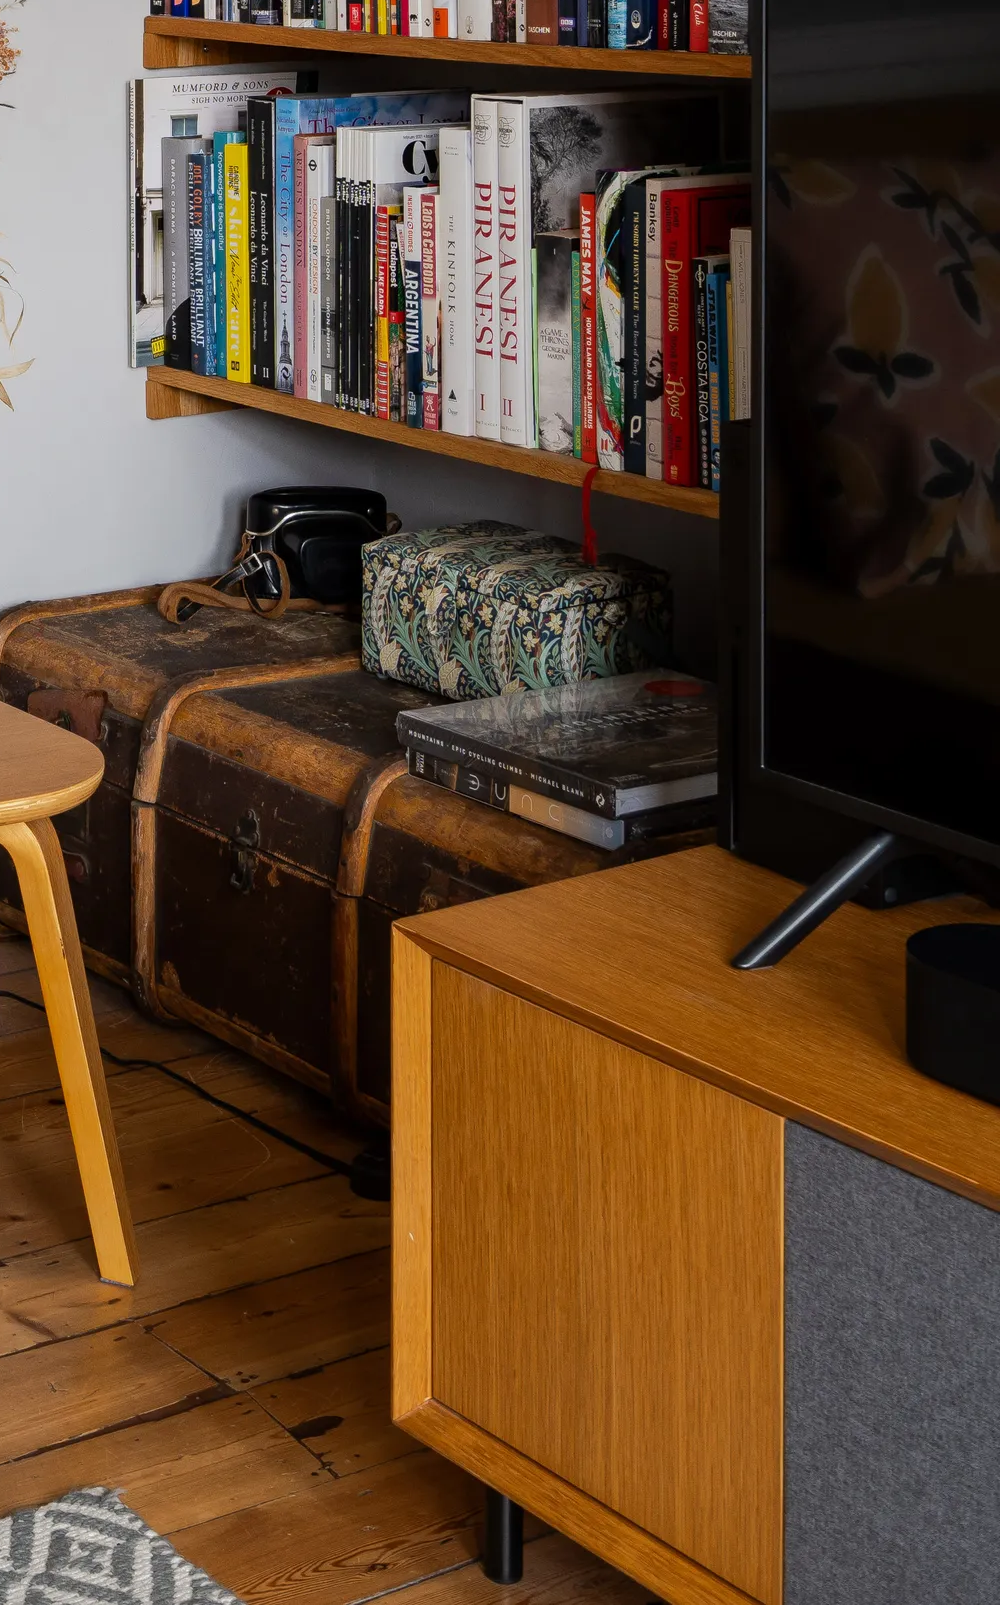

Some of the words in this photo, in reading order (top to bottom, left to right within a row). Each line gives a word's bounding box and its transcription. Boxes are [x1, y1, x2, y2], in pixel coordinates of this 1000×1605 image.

[172, 82, 228, 93] MUMFORD
[232, 82, 239, 91] &
[243, 81, 269, 89] SONS
[249, 191, 257, 238] Leonardo
[260, 193, 268, 240] Leonardo
[648, 193, 657, 242] Banksy
[250, 240, 257, 253] da
[261, 243, 268, 256] da
[581, 206, 591, 259] JAMES
[312, 244, 318, 257] BY
[250, 257, 258, 283] Vinci
[261, 259, 269, 285] Vinci
[447, 240, 456, 313] KINFOLK
[582, 262, 591, 296] MAY
[405, 269, 419, 354] ARGENTINA
[540, 336, 569, 346] THRONES
[696, 340, 707, 386] COSTA
[698, 390, 708, 423] RICA
[408, 729, 445, 748] MOUNTAINS
[451, 744, 466, 757] EPIC
[468, 751, 496, 765] CYCLING
[498, 761, 523, 775] CLIMBS
[530, 772, 560, 789] MICHAEL
[562, 785, 585, 798] BLANN
